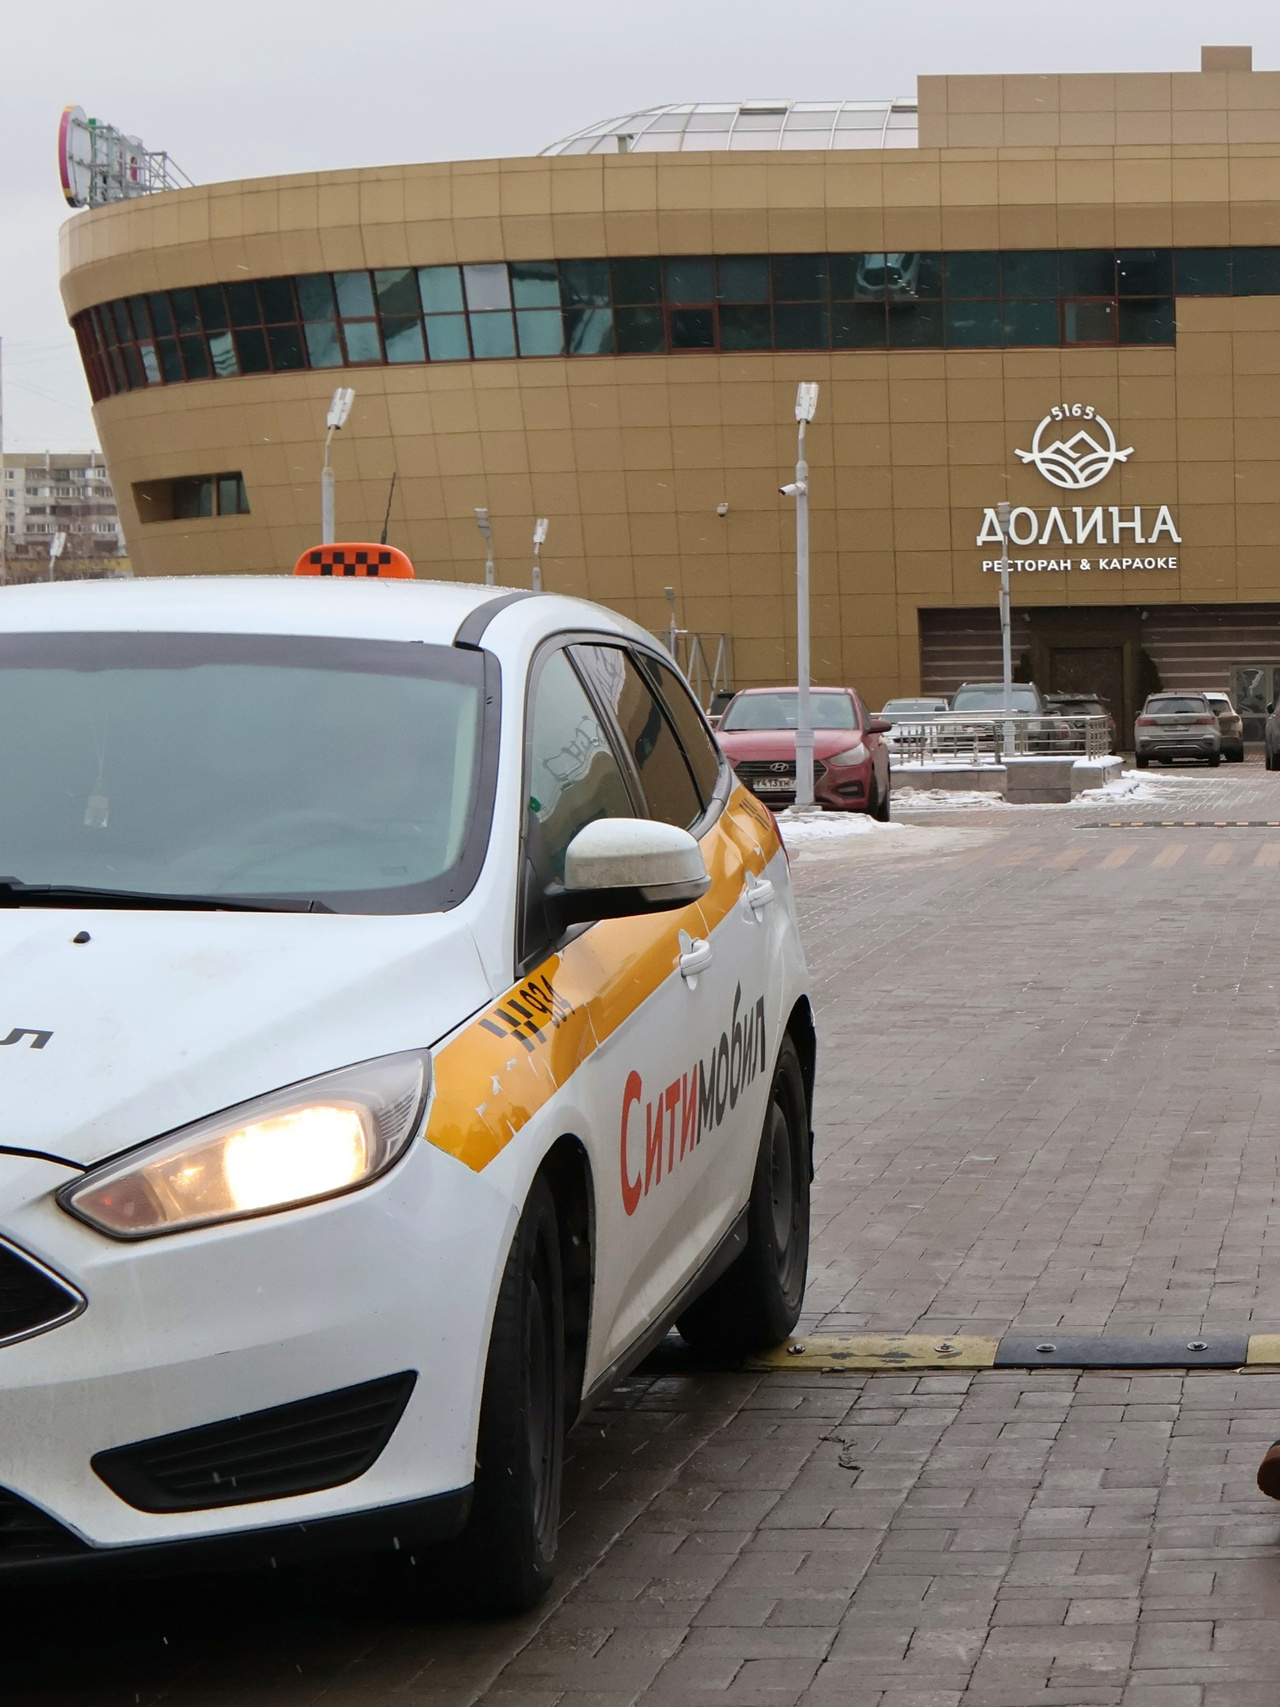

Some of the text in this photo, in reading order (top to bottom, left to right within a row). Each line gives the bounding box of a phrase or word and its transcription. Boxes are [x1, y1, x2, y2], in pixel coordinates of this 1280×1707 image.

[1050, 403, 1095, 421] 5165
[976, 505, 1182, 546] ДОЛИНА
[1079, 559, 1091, 570] &
[1099, 557, 1177, 570] КАРАОКЕ
[620, 980, 766, 1217] Ситимобил
